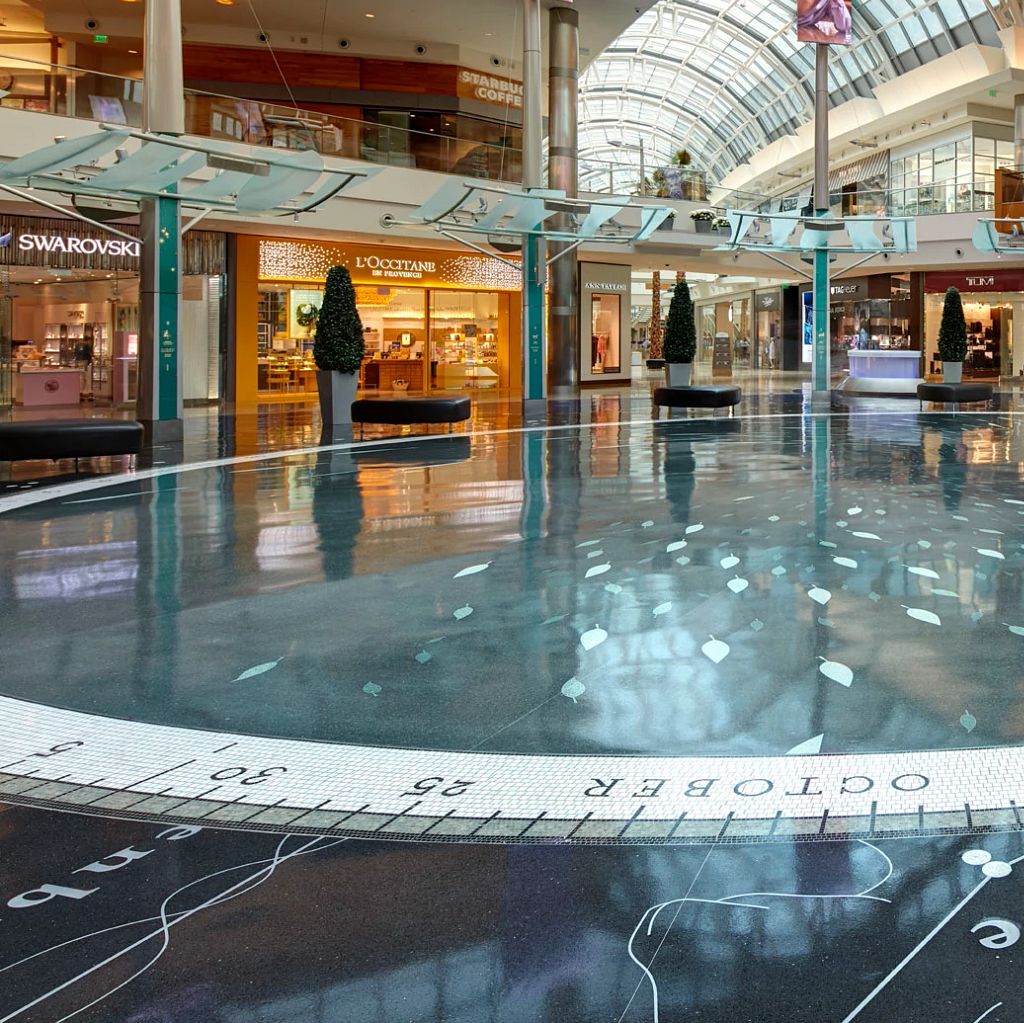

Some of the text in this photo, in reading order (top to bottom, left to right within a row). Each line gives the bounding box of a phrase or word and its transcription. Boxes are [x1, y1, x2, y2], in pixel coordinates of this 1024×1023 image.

[459, 70, 523, 95] STARBU
[475, 87, 522, 106] COFFE
[19, 234, 140, 256] SWAROVSKI
[355, 255, 436, 273] L'OCCITANE
[965, 276, 994, 286] TUMI
[34, 739, 84, 757] 5
[210, 765, 288, 786] 30
[583, 773, 930, 798] OCTOBER
[399, 775, 476, 798] 25
